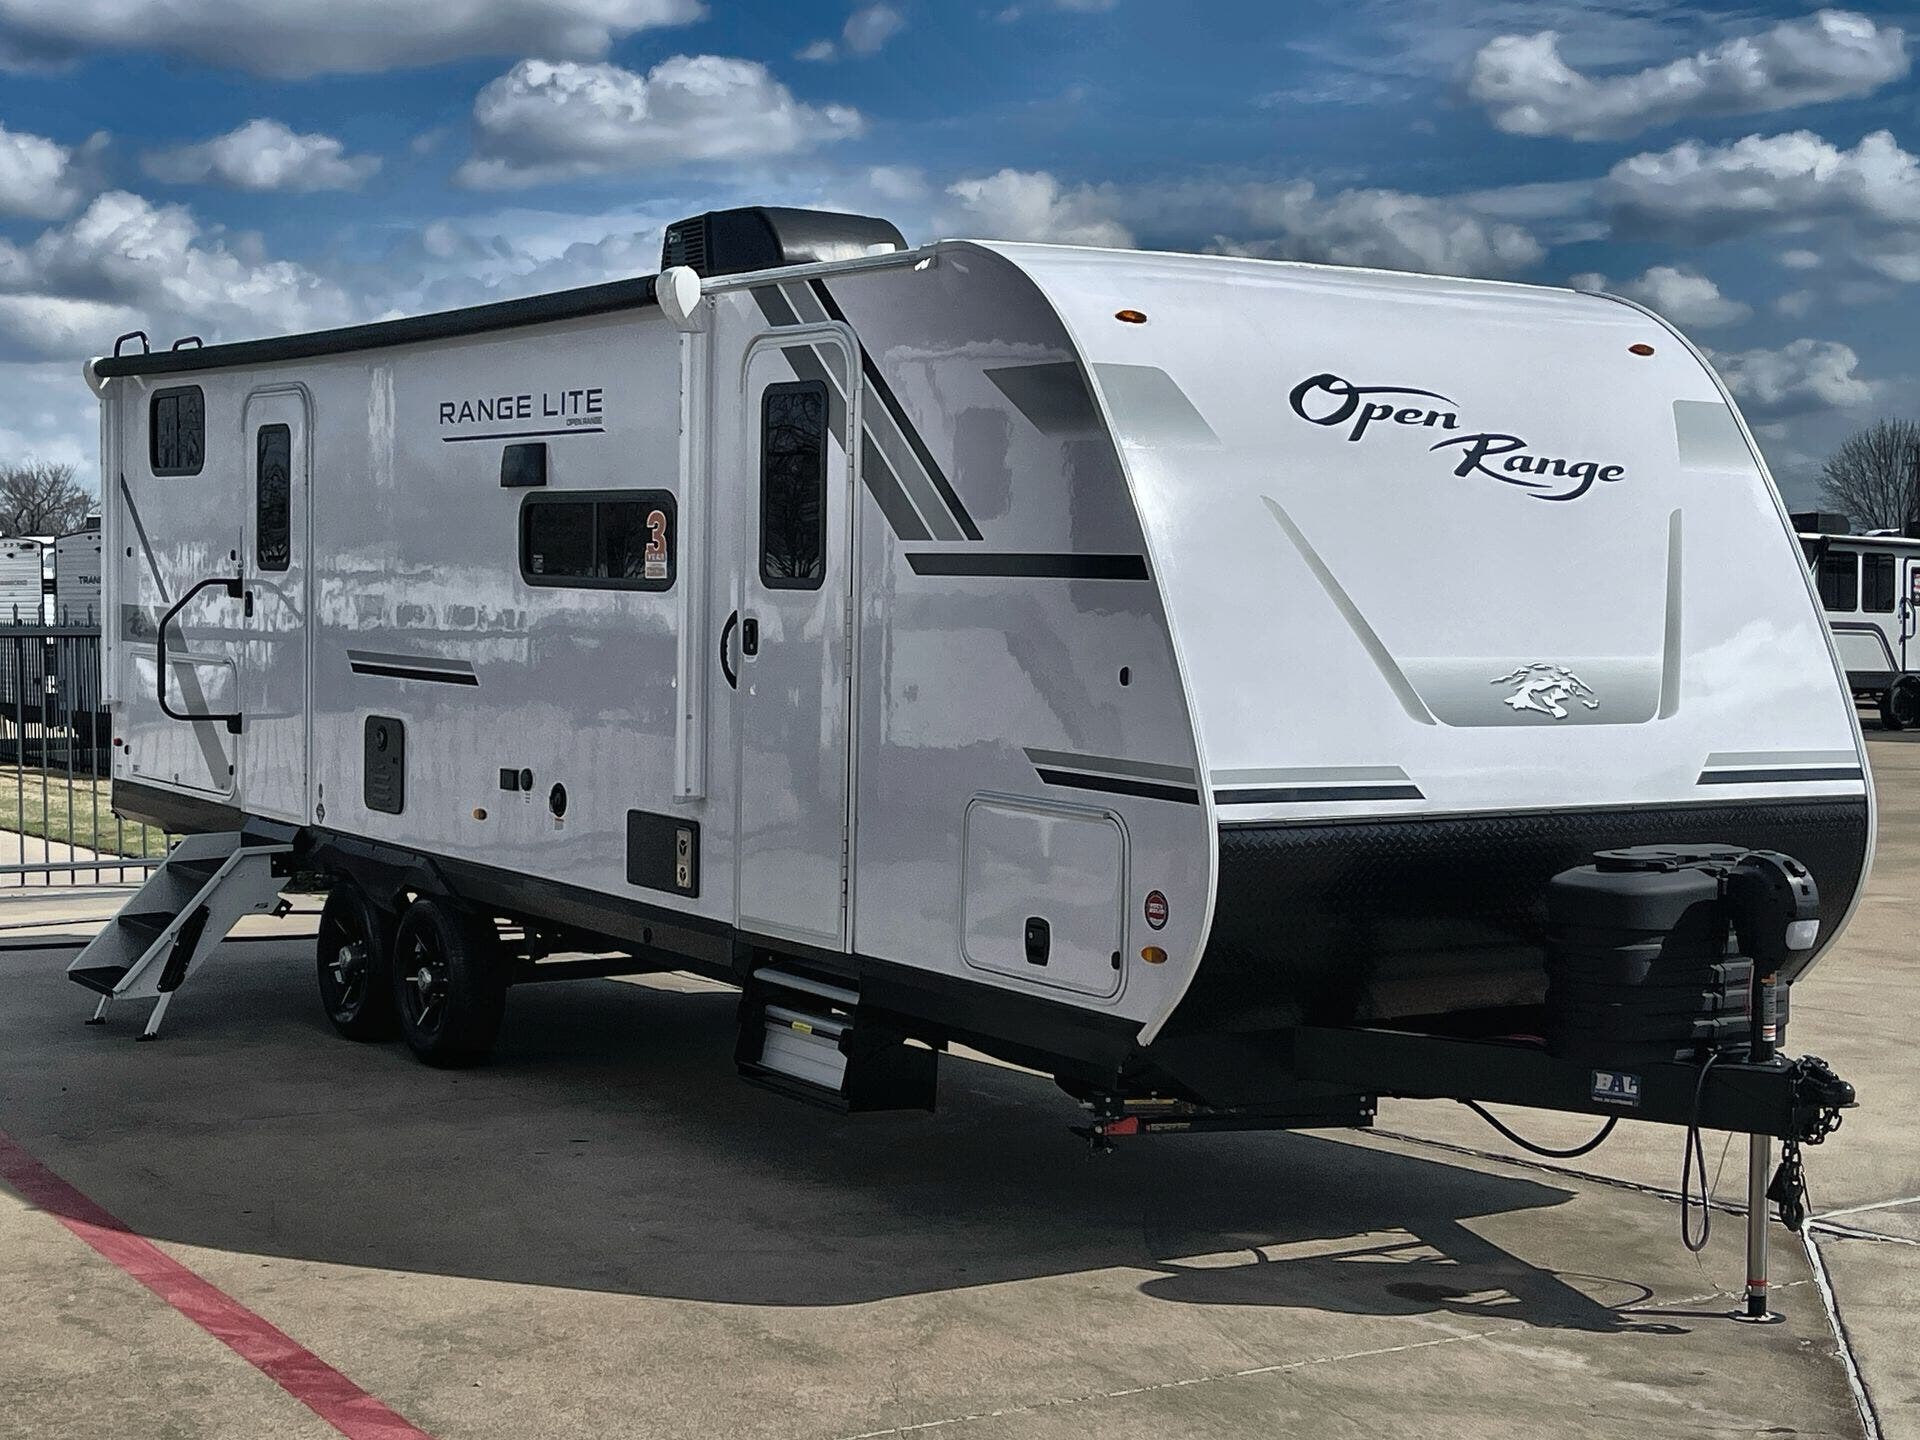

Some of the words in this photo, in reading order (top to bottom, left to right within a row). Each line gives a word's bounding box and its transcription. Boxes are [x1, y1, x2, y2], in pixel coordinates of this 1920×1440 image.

[440, 395, 531, 424] RANGE
[543, 388, 603, 416] LITE
[1289, 373, 1460, 442] Open
[1429, 433, 1625, 501] Range
[646, 510, 667, 554] 3
[1595, 1072, 1638, 1094] BAL
